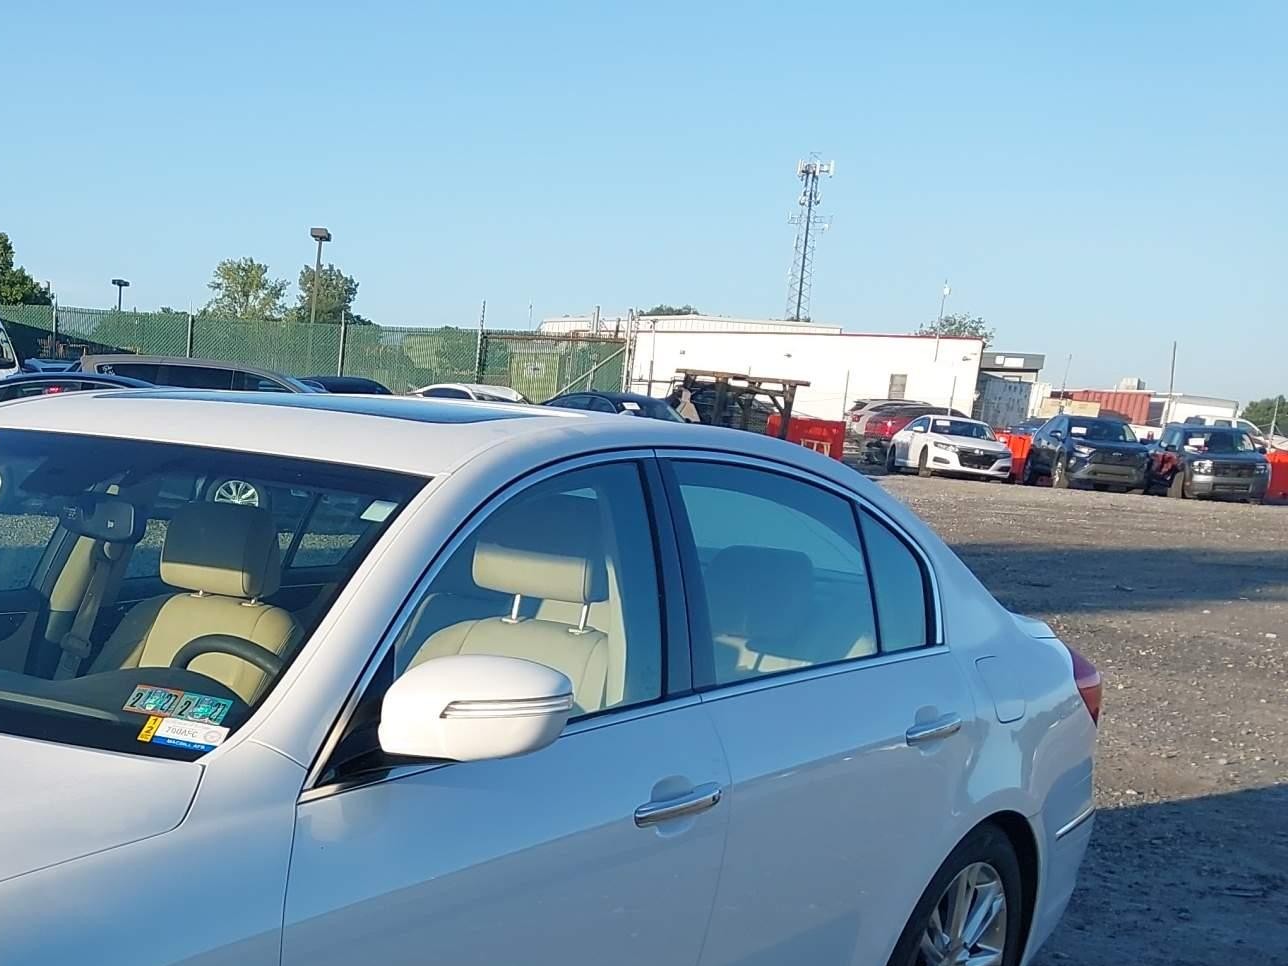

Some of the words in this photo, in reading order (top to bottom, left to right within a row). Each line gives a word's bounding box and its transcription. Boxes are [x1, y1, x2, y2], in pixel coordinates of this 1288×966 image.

[130, 692, 144, 708] 2
[160, 693, 178, 712] 27
[178, 700, 192, 716] 2
[209, 702, 227, 721] 27
